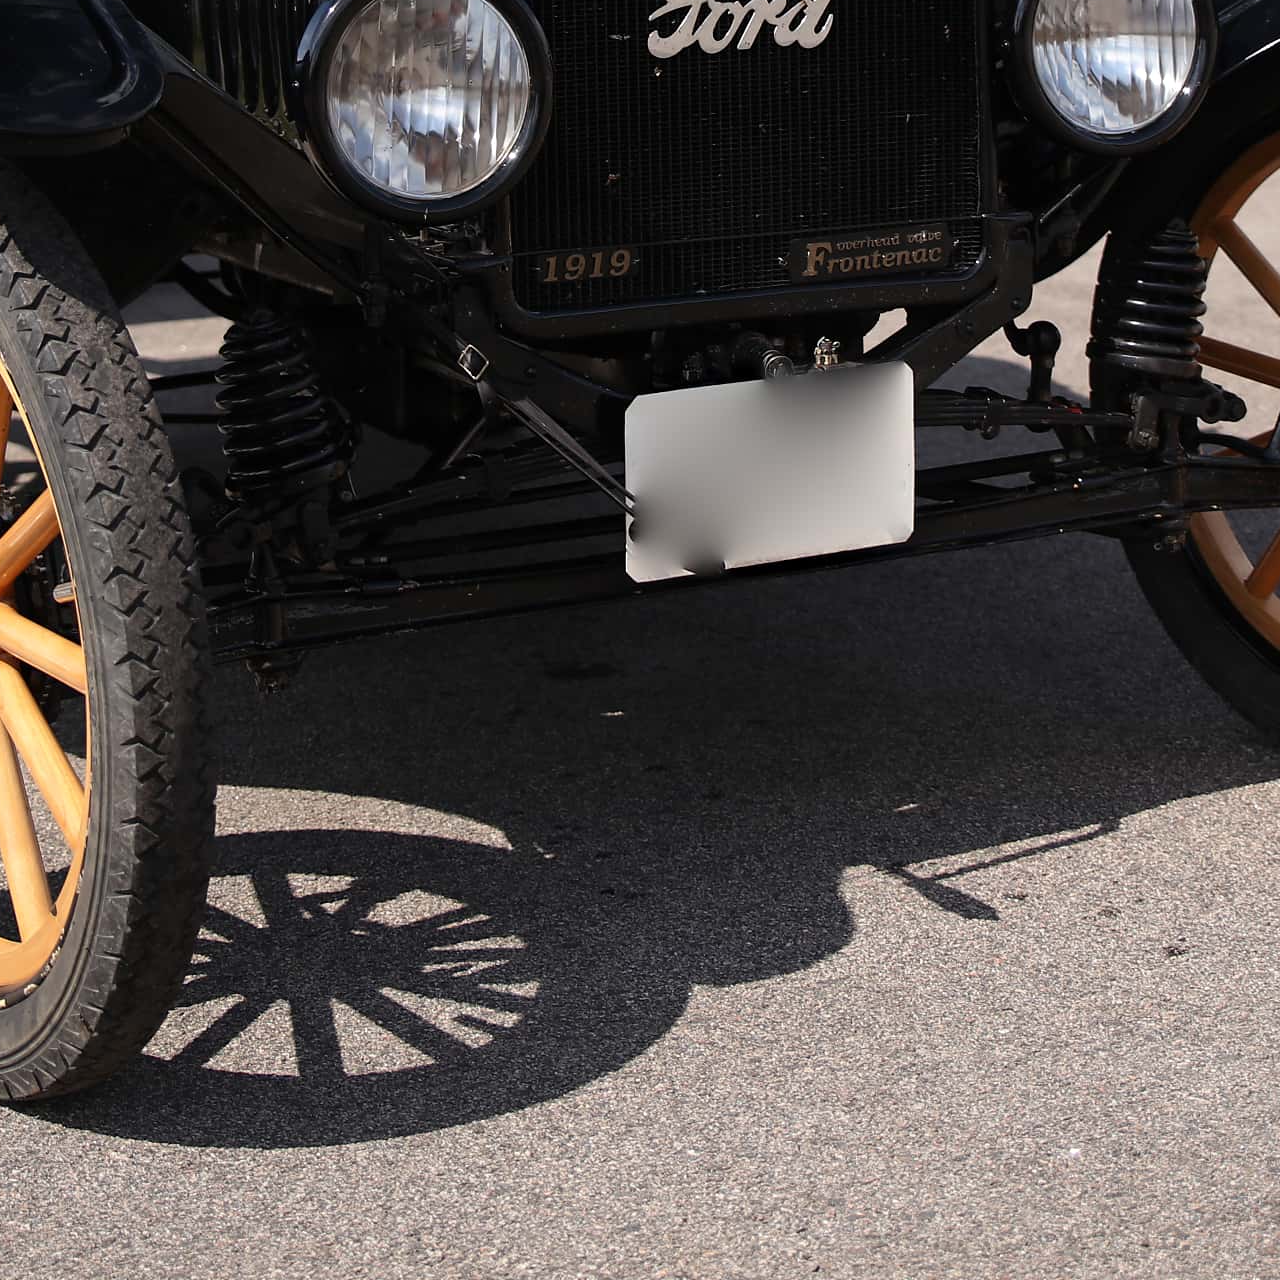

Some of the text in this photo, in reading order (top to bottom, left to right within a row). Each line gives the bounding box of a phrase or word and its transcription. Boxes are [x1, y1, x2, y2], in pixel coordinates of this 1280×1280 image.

[835, 229, 942, 251] overhead valve
[543, 247, 632, 283] 1919
[801, 242, 943, 277] Frontenac
